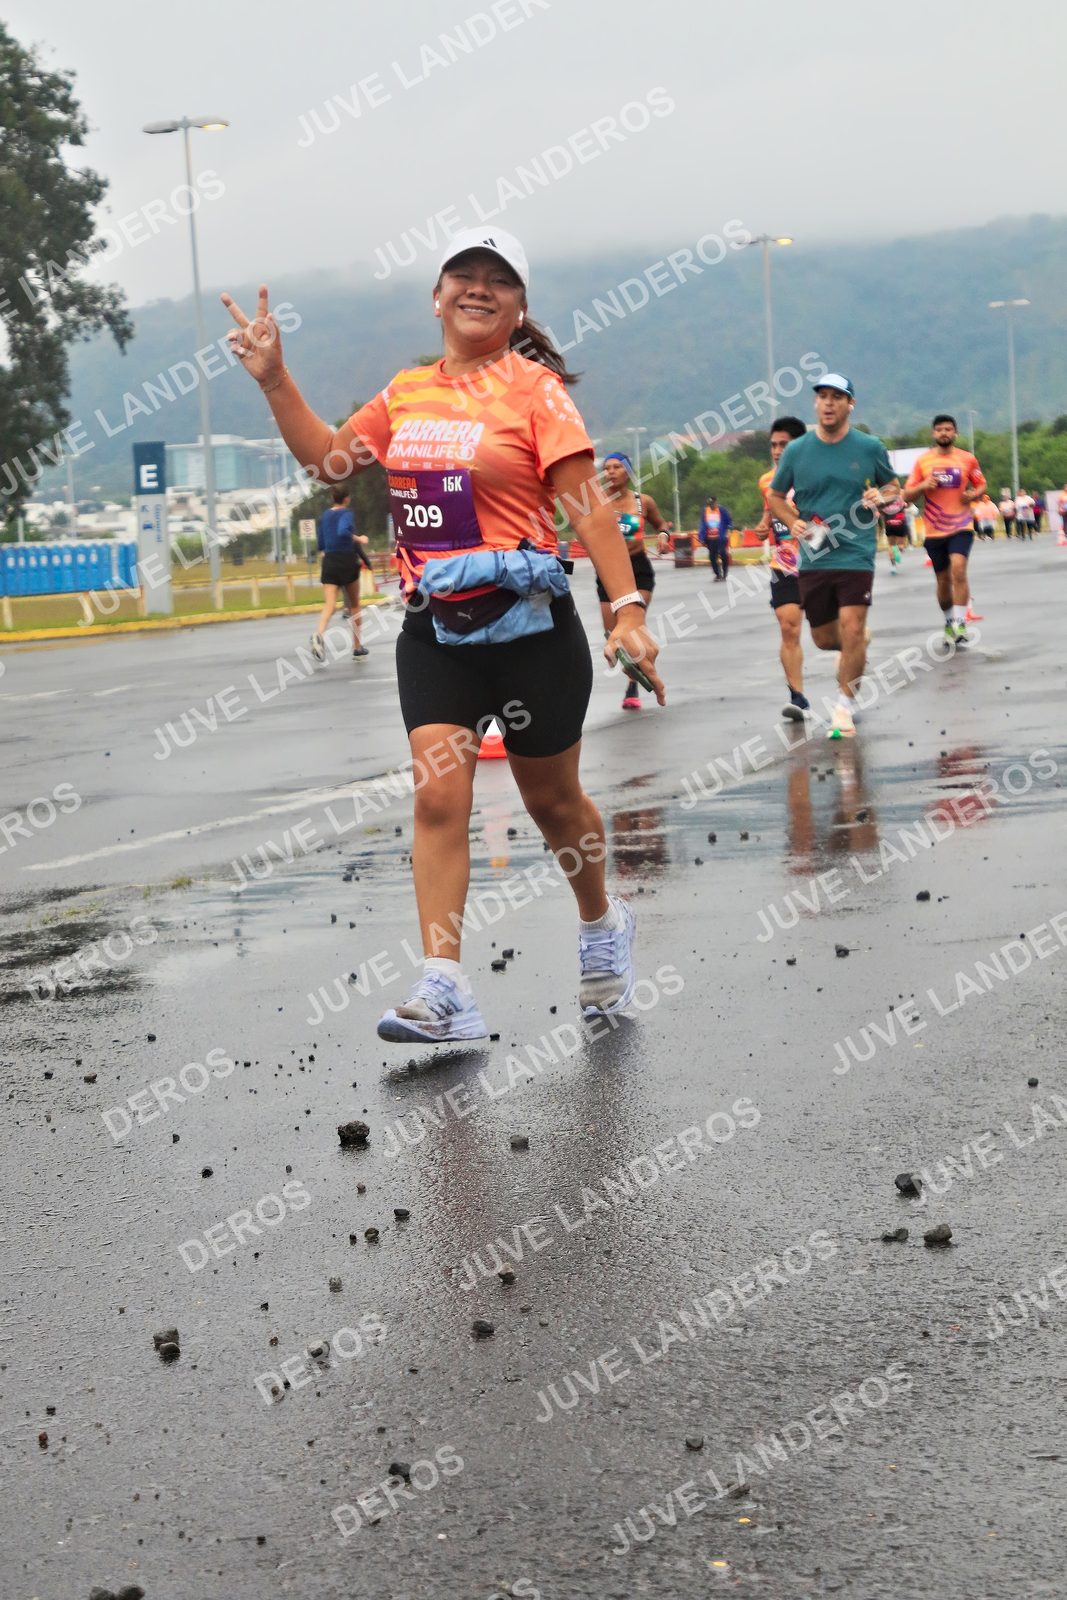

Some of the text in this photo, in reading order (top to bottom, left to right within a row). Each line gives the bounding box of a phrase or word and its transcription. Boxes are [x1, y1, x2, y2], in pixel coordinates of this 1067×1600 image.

[394, 418, 485, 442] CARRERA
[141, 464, 159, 488] E
[442, 476, 463, 492] 15K
[403, 504, 443, 528] 209
